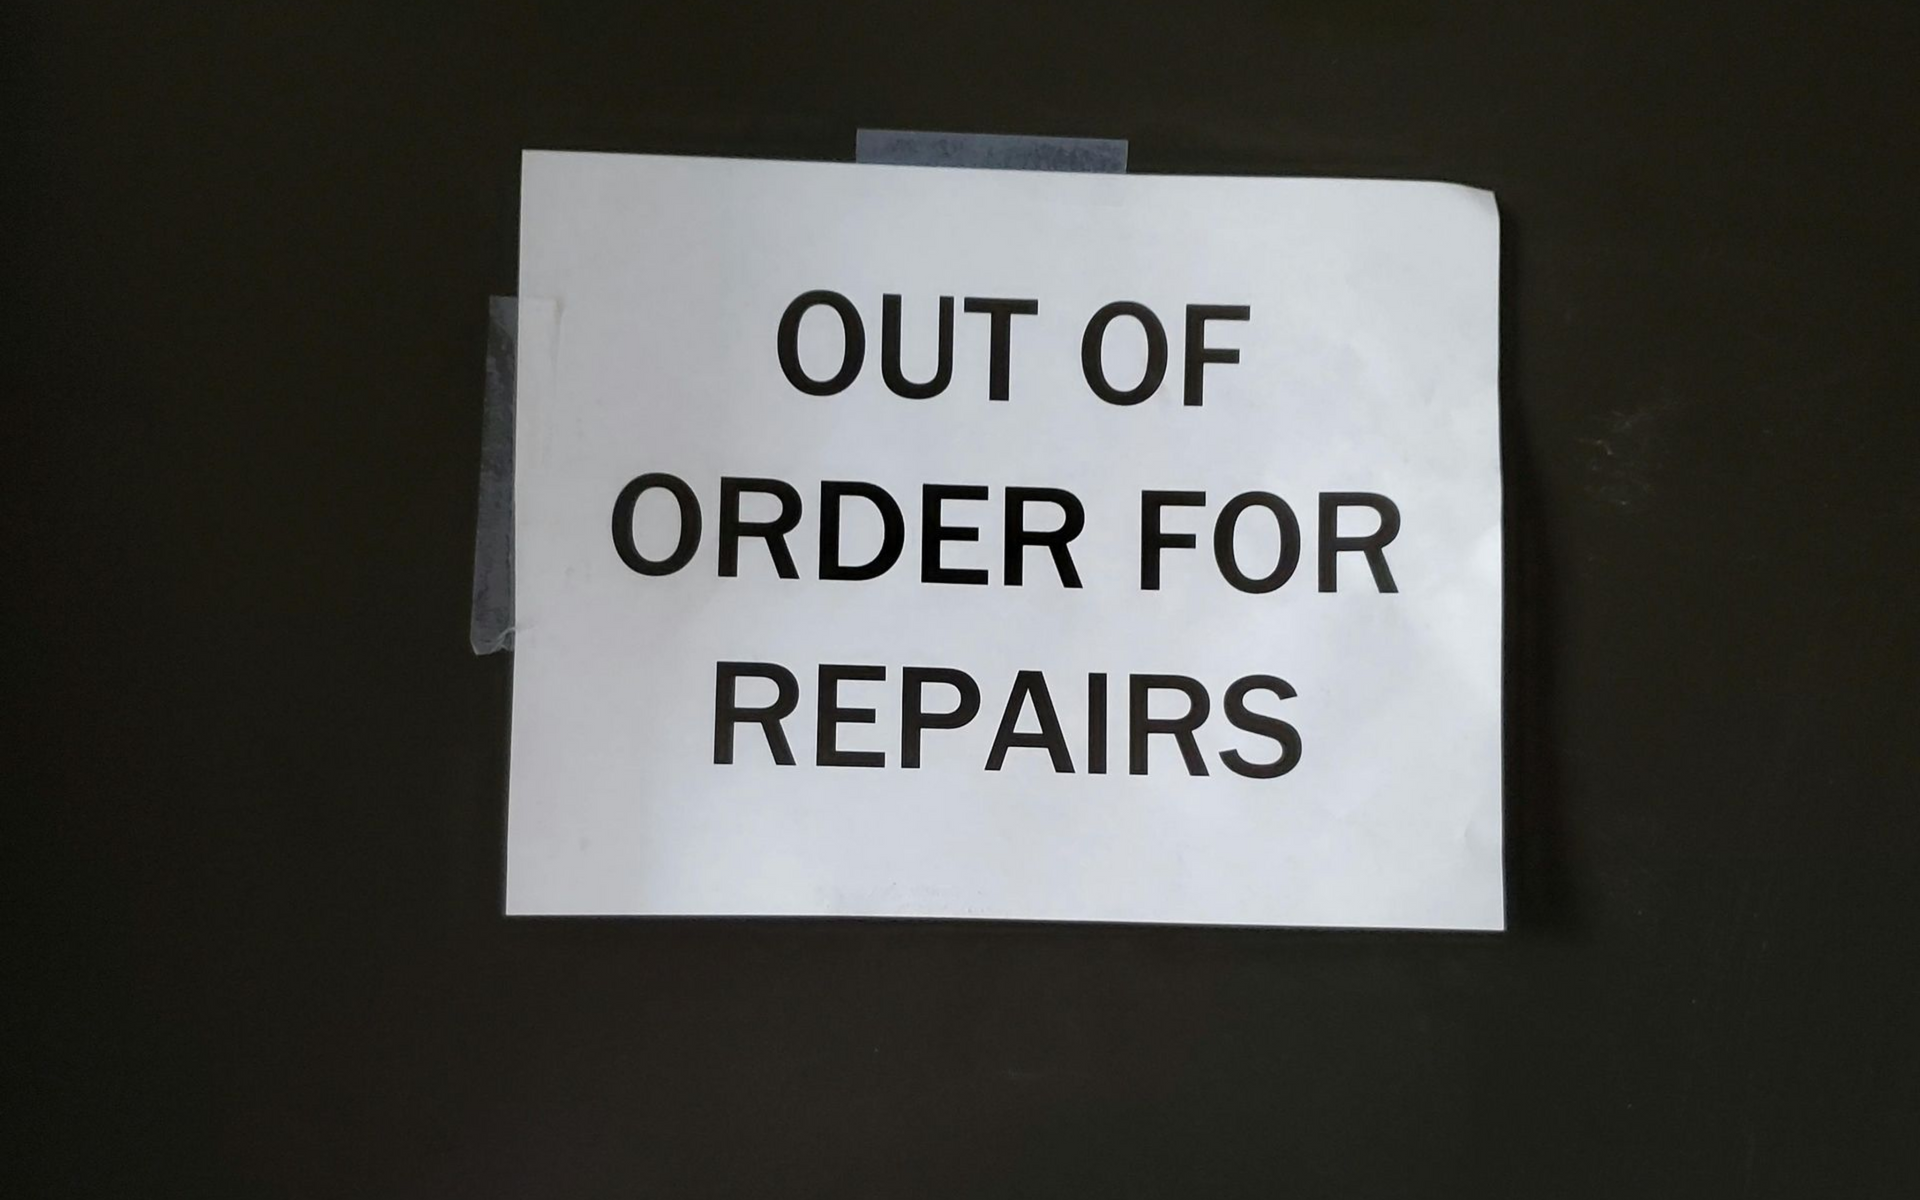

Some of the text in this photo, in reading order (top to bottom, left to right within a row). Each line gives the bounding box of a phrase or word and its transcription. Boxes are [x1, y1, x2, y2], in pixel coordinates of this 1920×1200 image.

[778, 290, 1250, 406] OUT OF
[612, 473, 1400, 594] ORDER FOR
[714, 662, 1301, 779] REPAIRS
